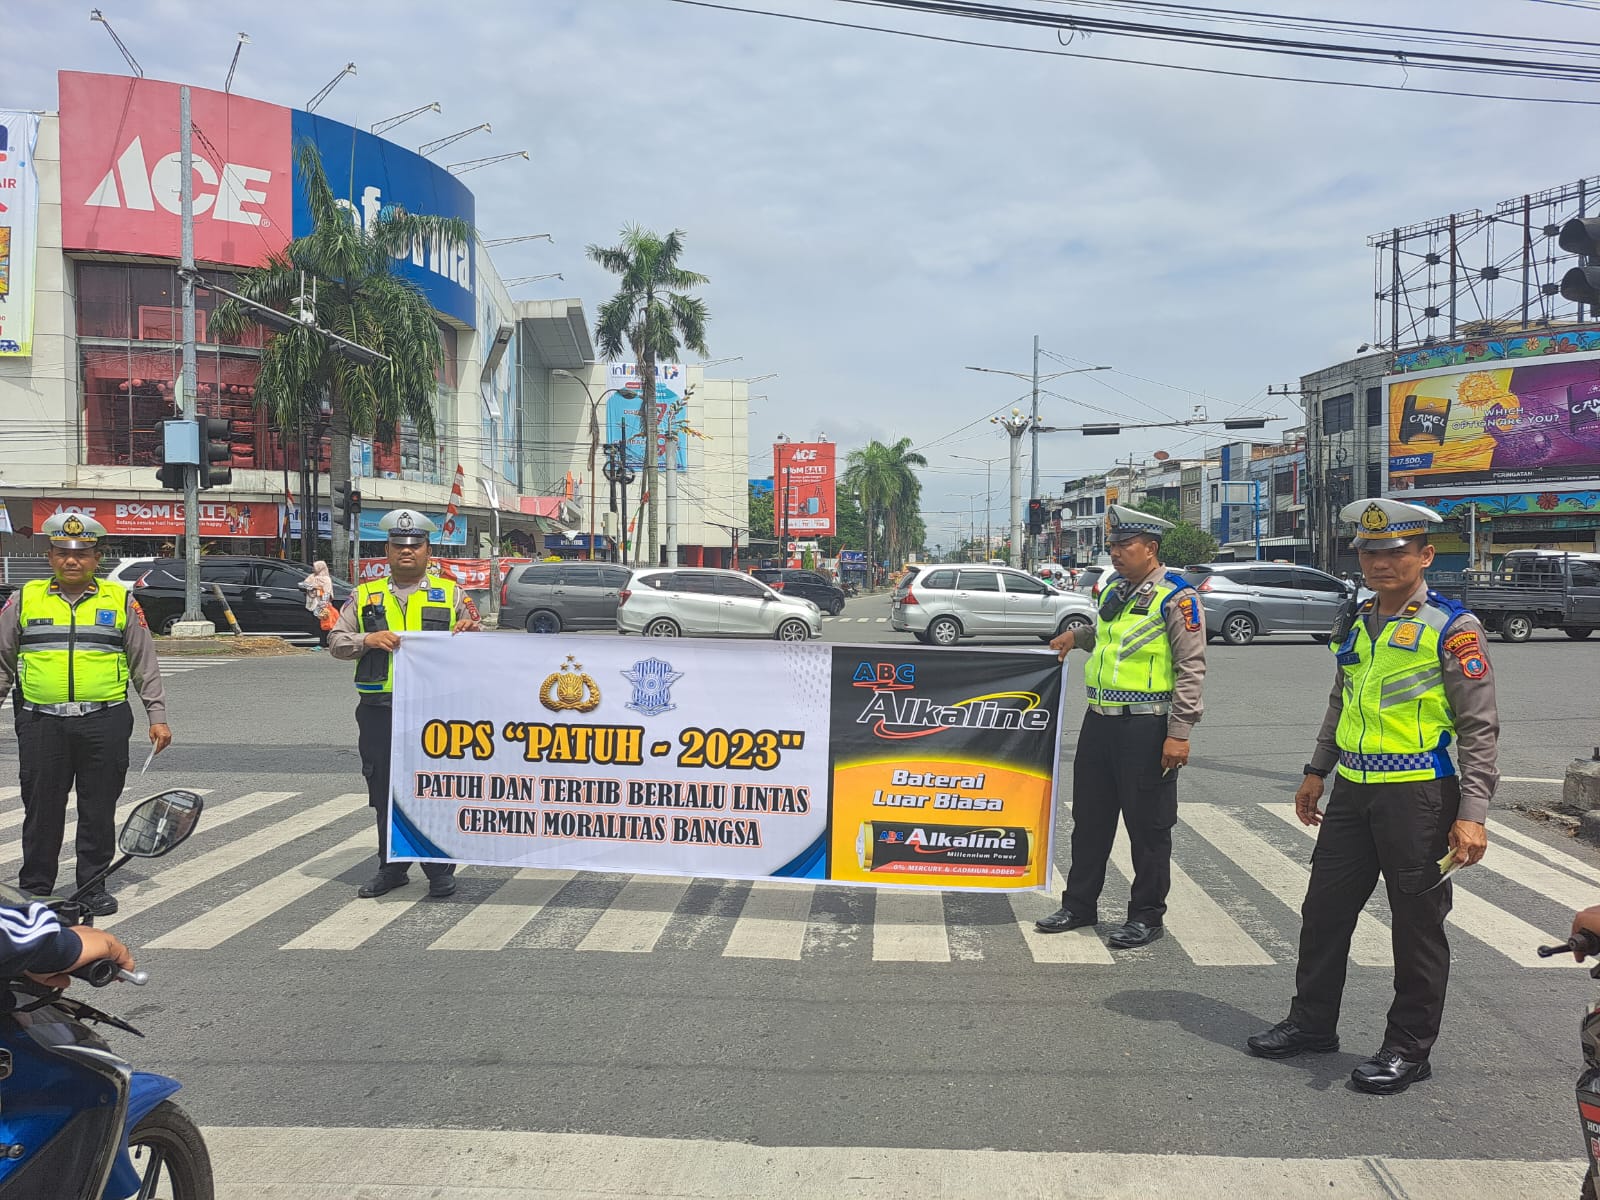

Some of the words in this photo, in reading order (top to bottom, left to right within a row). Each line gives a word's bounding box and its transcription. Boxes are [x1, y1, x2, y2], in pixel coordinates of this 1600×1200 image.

[84, 135, 271, 226] ACE
[1409, 414, 1446, 427] CAMEL
[1452, 420, 1497, 431] OPTION
[1499, 417, 1523, 427] ARE
[1527, 413, 1560, 424] YOU?
[1484, 407, 1524, 417] WHICH
[792, 448, 817, 460] ACE
[805, 466, 826, 475] SALE
[853, 662, 915, 682] ABC
[856, 691, 1050, 730] Alkaline
[422, 719, 496, 760] OPS
[651, 740, 673, 757] -
[892, 769, 985, 790] Baterai
[415, 772, 484, 800] PATUH
[490, 775, 535, 803] DAN
[540, 777, 622, 806] TERTIB
[627, 780, 726, 810] BERLALU
[732, 784, 810, 814] LINTAS
[873, 790, 930, 809] Luar
[933, 793, 1004, 811] Biasa
[457, 807, 536, 835] CERMIN
[542, 811, 667, 842] MORALITAS
[671, 816, 762, 848] BANGSA
[880, 830, 903, 843] ABC
[904, 828, 1016, 849] Alkaline
[947, 851, 990, 859] Millennium
[953, 866, 988, 874] CADMIUM
